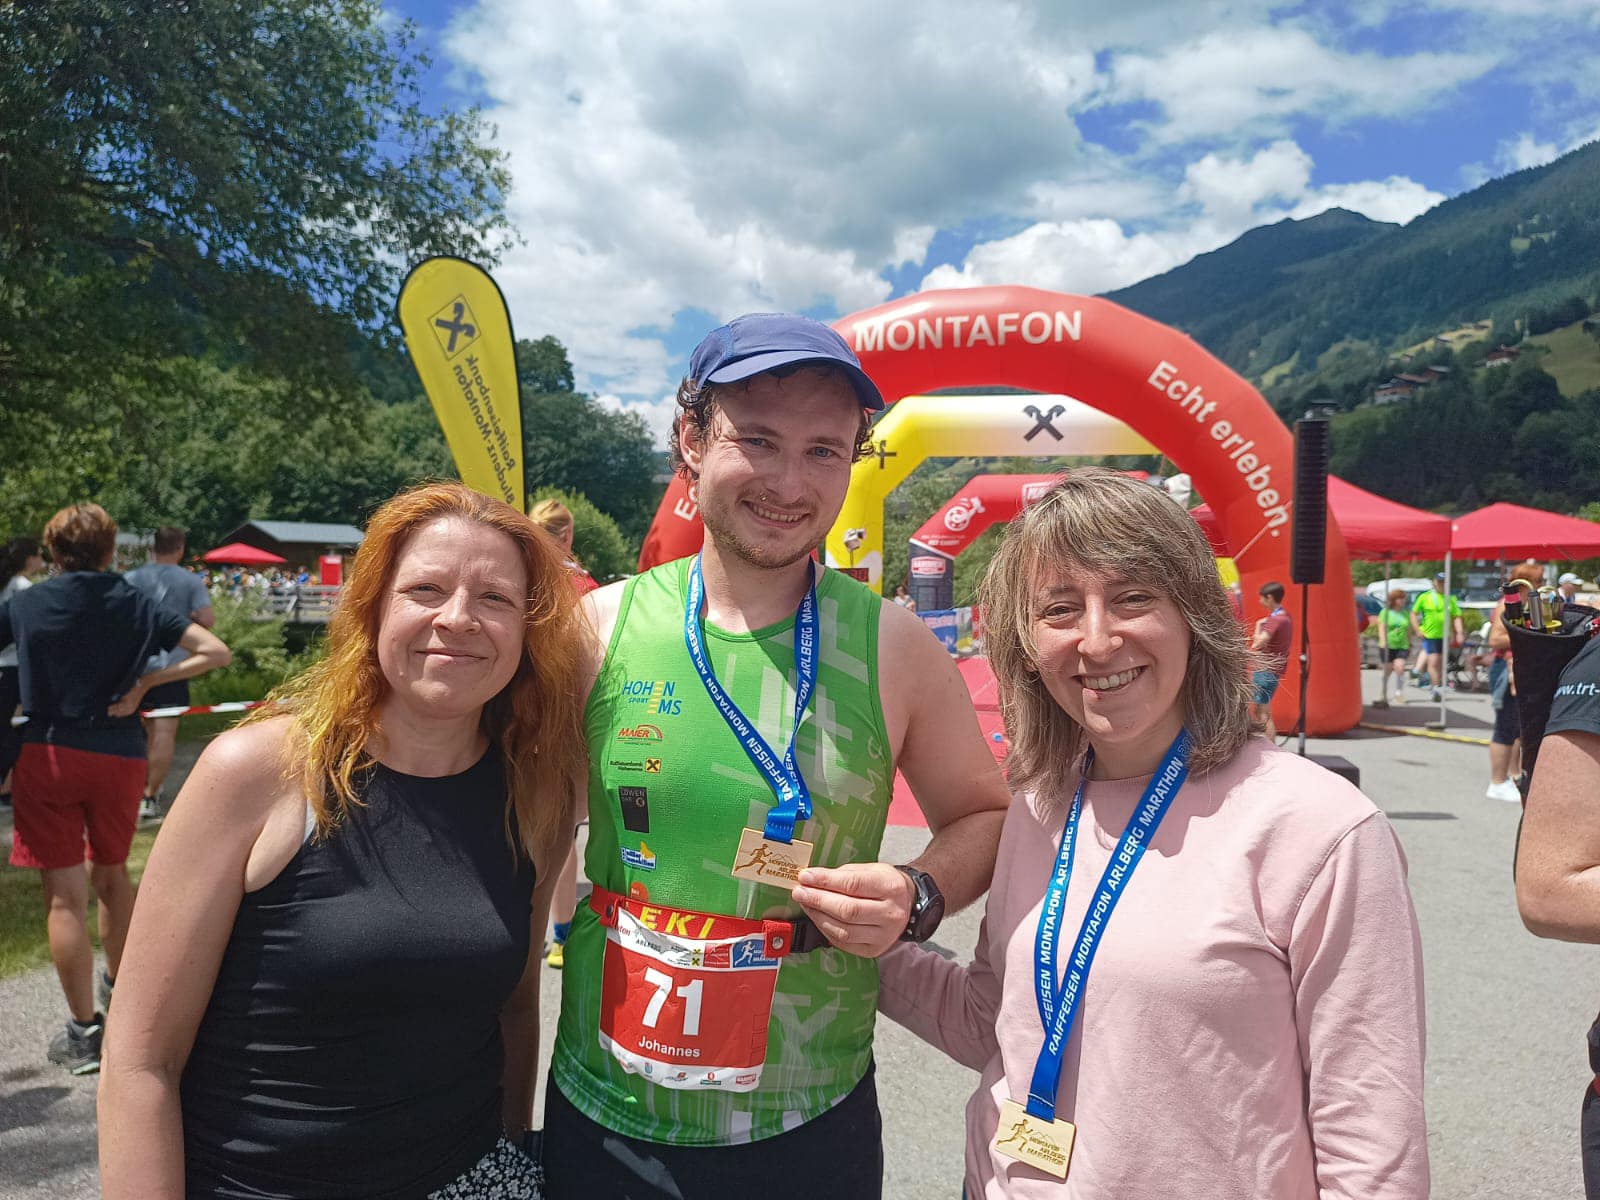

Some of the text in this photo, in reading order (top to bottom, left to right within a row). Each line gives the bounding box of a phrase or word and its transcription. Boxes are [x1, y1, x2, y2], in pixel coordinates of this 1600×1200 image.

[852, 310, 1082, 352] MONTAFON
[1147, 360, 1289, 538] Echt erleben.
[800, 626, 814, 679] ARLBERG
[618, 727, 649, 738] MAIER
[705, 677, 750, 737] MONTAFON
[746, 737, 794, 802] RAIFFEISEN
[626, 902, 716, 939] EKI
[1040, 890, 1062, 965] MONTAFON
[1056, 826, 1074, 887] ARLBERG
[1049, 970, 1081, 1056] RAIFFEISEN
[1075, 891, 1112, 970] MONTAFON
[1107, 826, 1145, 891] ARLBERG
[1139, 757, 1184, 827] MARATHON
[642, 967, 703, 1036] 71
[638, 1036, 700, 1057] Johannes
